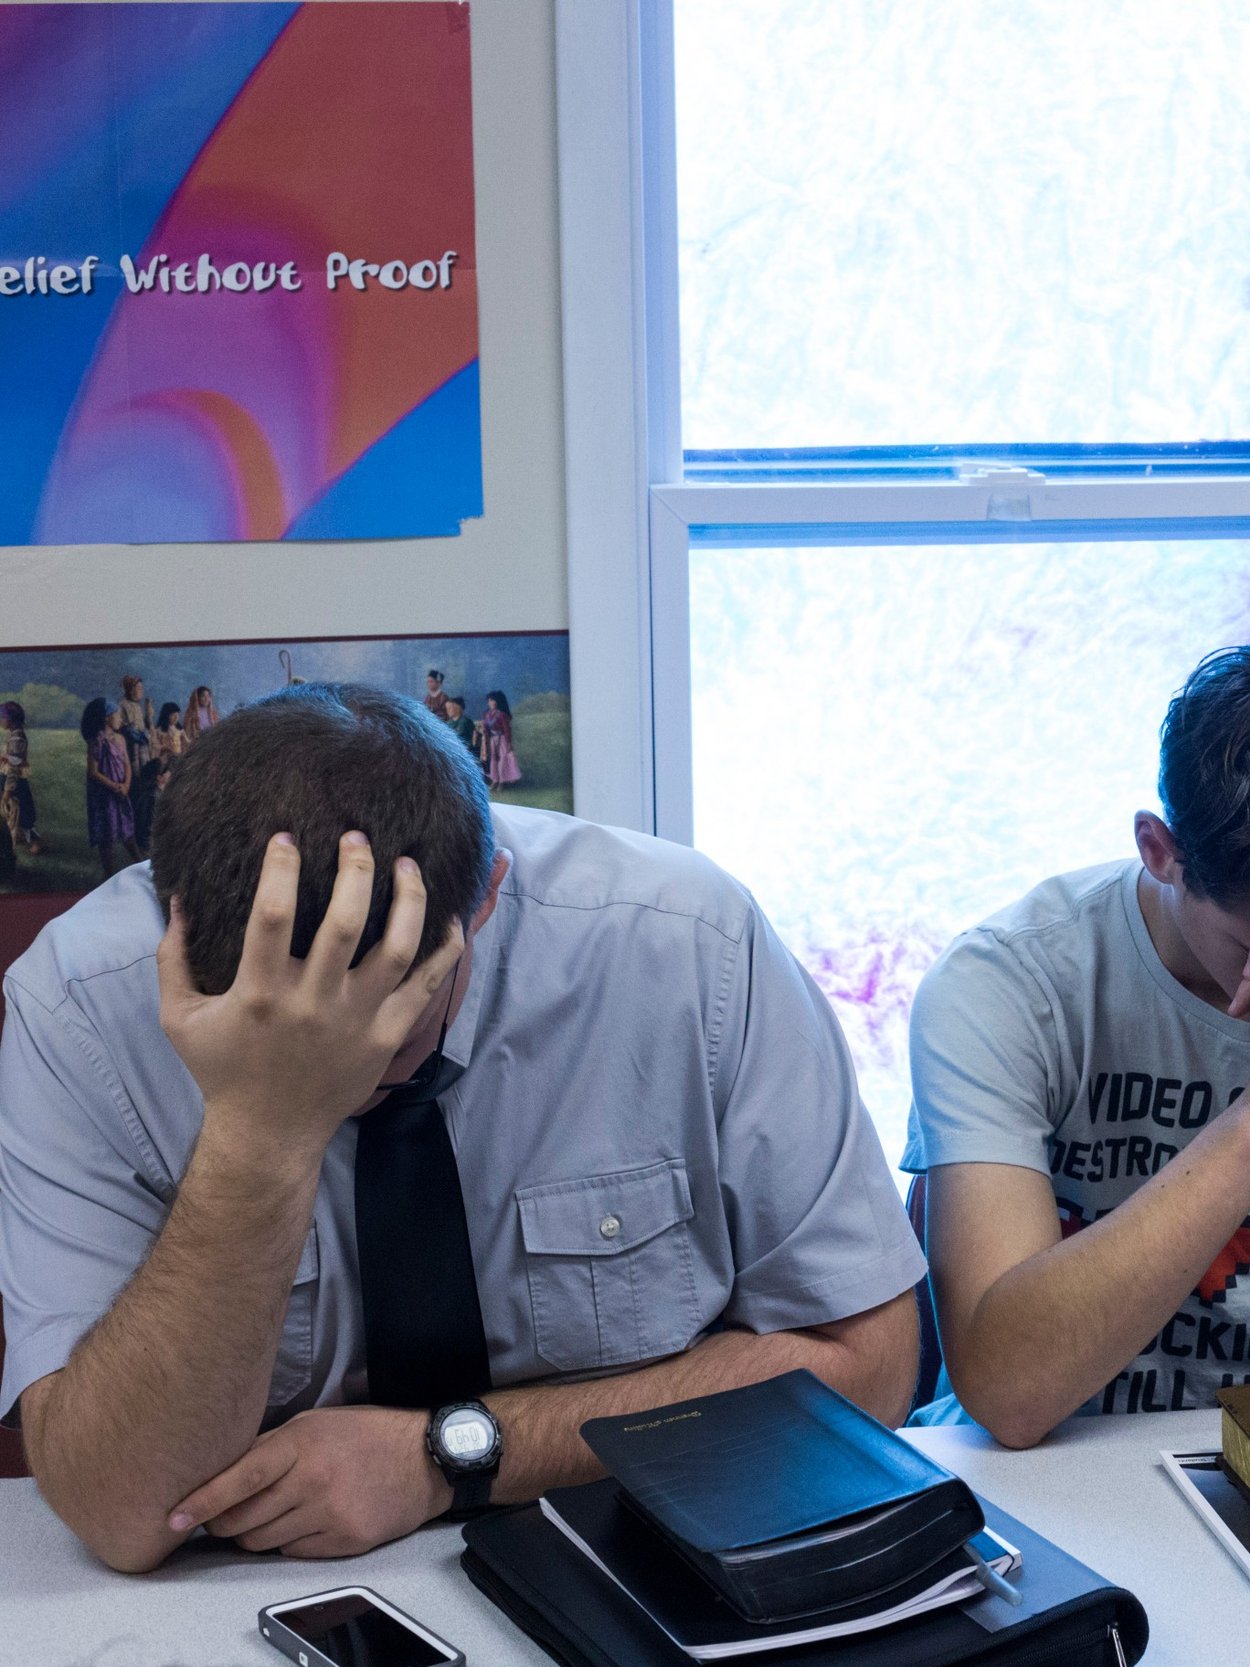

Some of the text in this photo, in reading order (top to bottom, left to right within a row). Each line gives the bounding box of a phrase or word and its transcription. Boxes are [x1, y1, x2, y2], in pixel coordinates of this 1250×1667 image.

[0, 250, 458, 295] elief Without Proof
[1088, 1072, 1213, 1129] VIDEO
